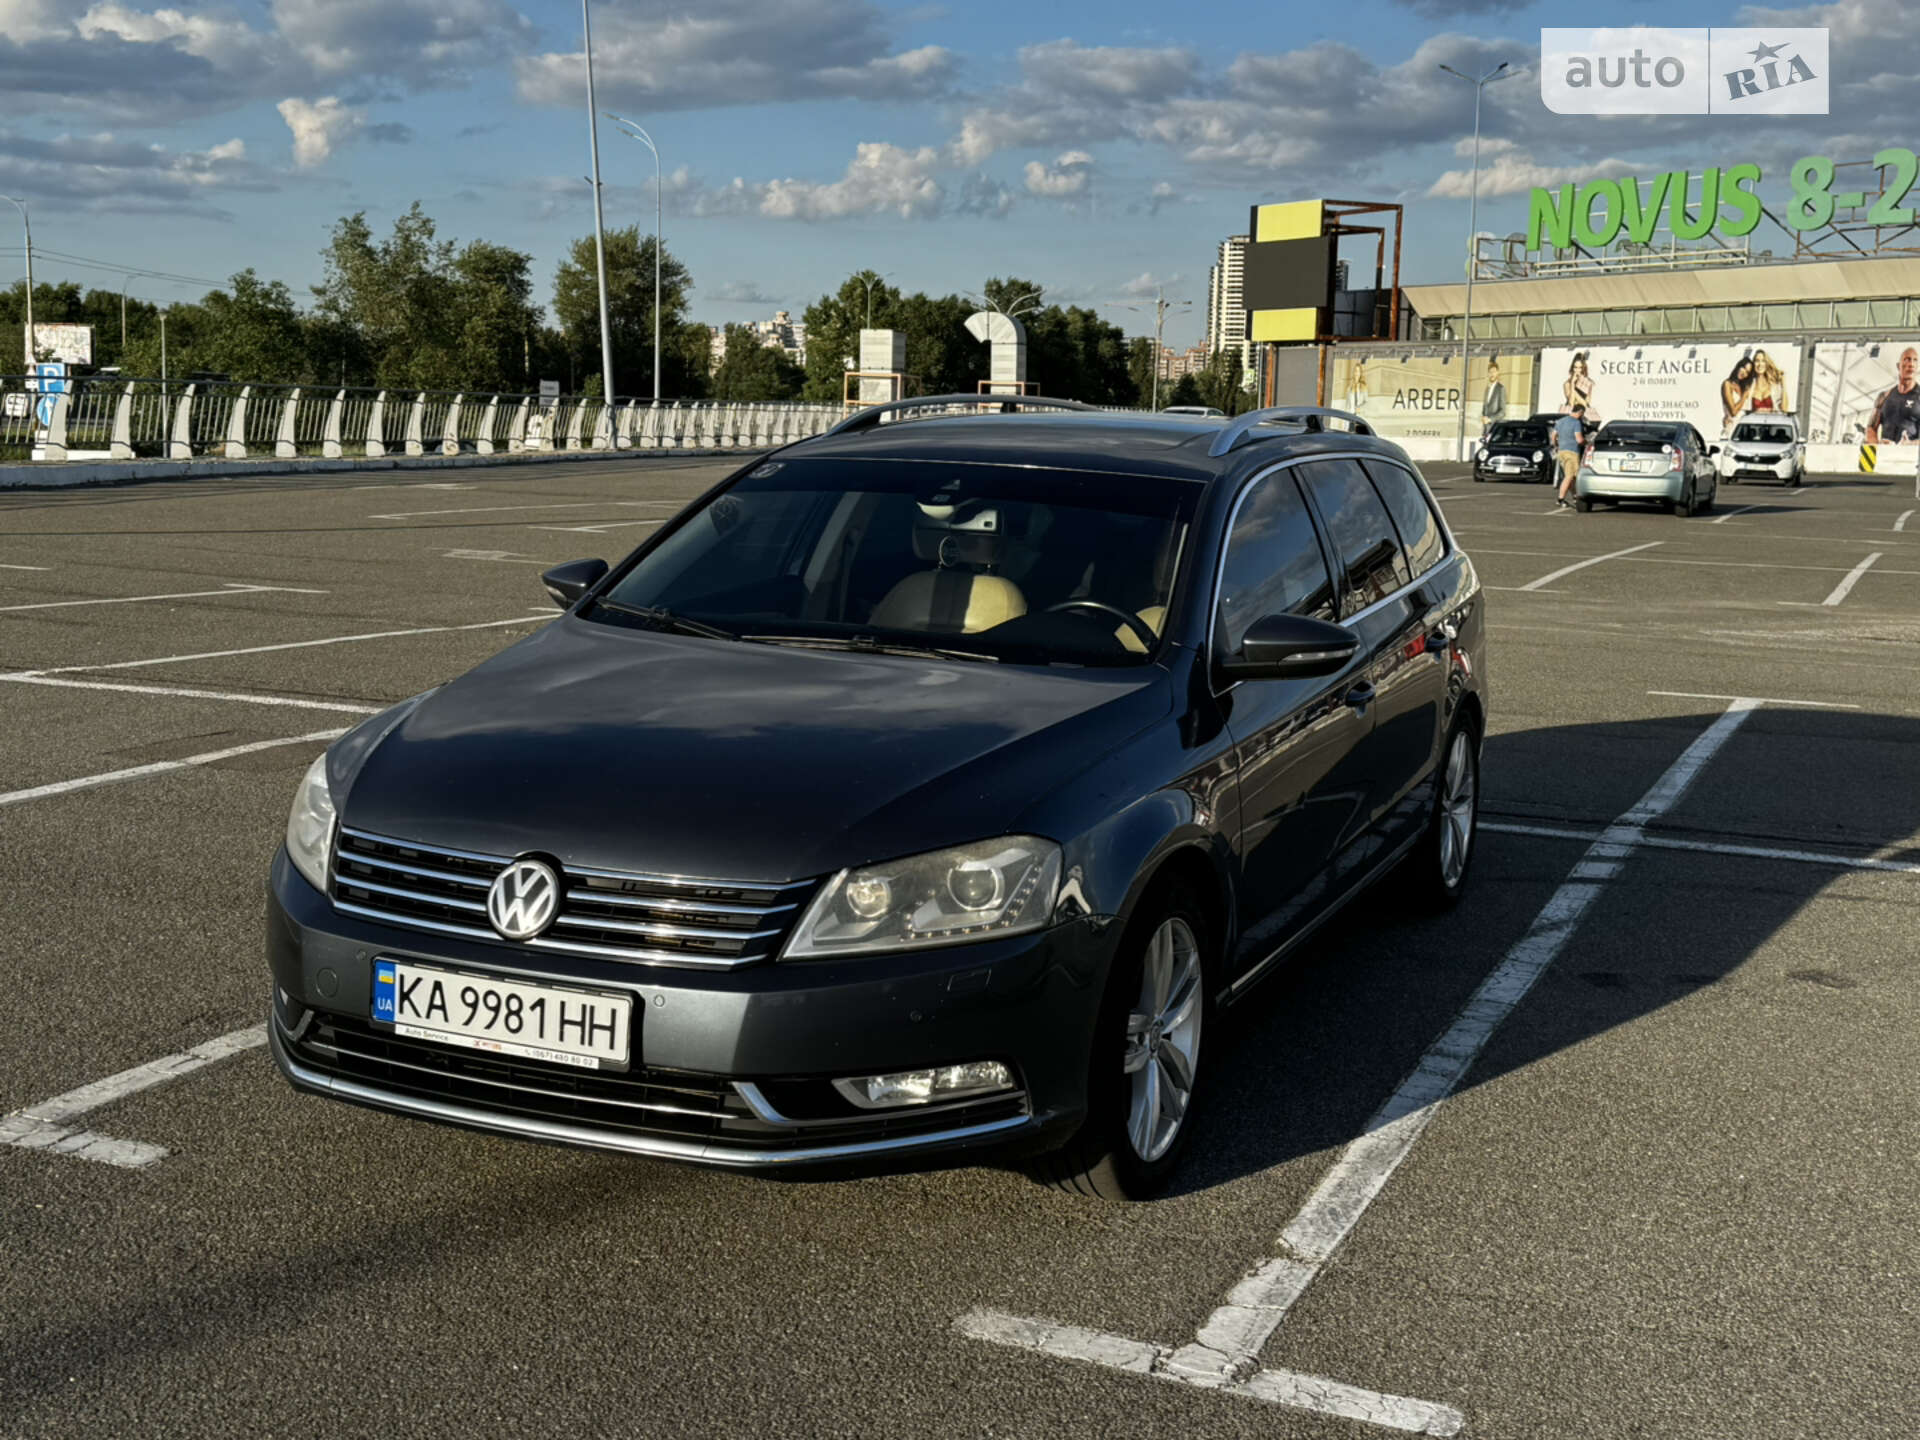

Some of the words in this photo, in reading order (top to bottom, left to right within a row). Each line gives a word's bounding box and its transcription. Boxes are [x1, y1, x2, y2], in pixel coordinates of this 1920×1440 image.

[1526, 163, 1762, 251] NOVUS
[1392, 388, 1460, 410] ARBER
[377, 998, 393, 1012] UA
[398, 974, 449, 1023] KA
[460, 986, 546, 1039] 9981
[559, 1000, 617, 1050] HH
[405, 1028, 422, 1036] Auto
[423, 1030, 449, 1041] Service
